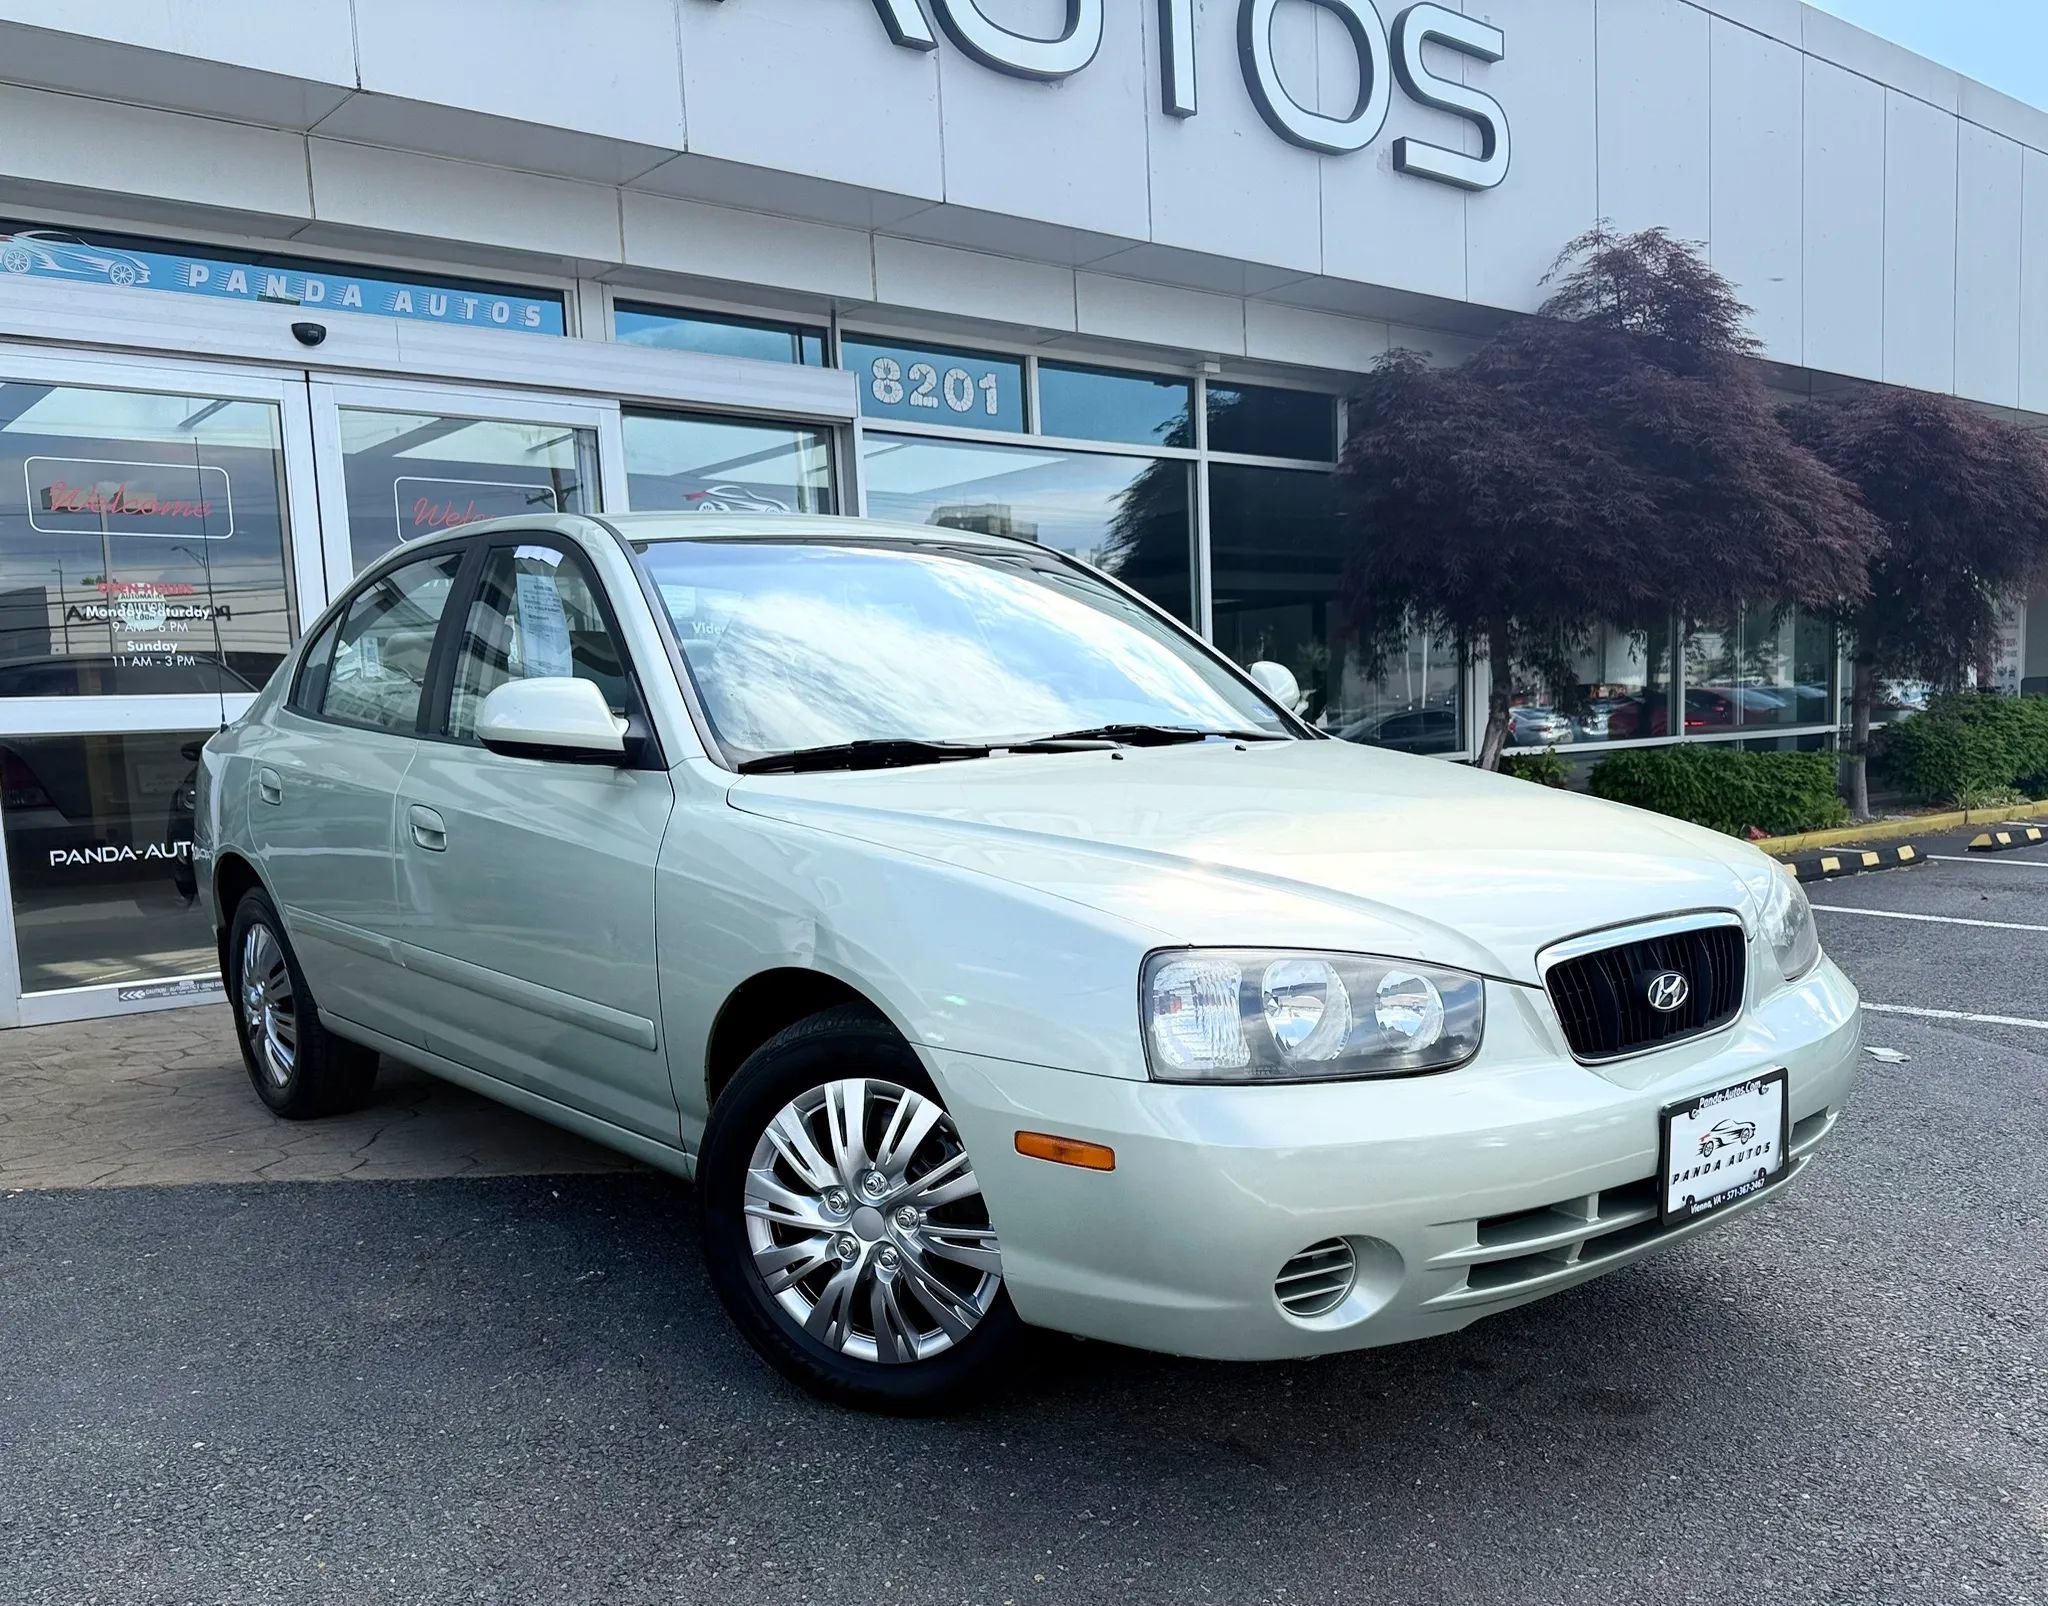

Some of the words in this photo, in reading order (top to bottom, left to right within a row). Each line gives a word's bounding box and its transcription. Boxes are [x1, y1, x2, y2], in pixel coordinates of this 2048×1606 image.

[184, 263, 362, 308] PANDA
[392, 290, 541, 327] AUTOS
[871, 356, 998, 416] 8201
[49, 480, 213, 518] Welcome
[112, 622, 120, 633] 9
[170, 621, 188, 633] PM
[112, 656, 126, 667] 11
[132, 656, 152, 667] AM
[165, 656, 173, 667] 3
[177, 655, 196, 667] PM
[127, 640, 178, 653] Sunday
[49, 840, 194, 867] PANDA-AUT
[1672, 1159, 1722, 1185] PANDA
[1729, 1142, 1771, 1166] AUTOS
